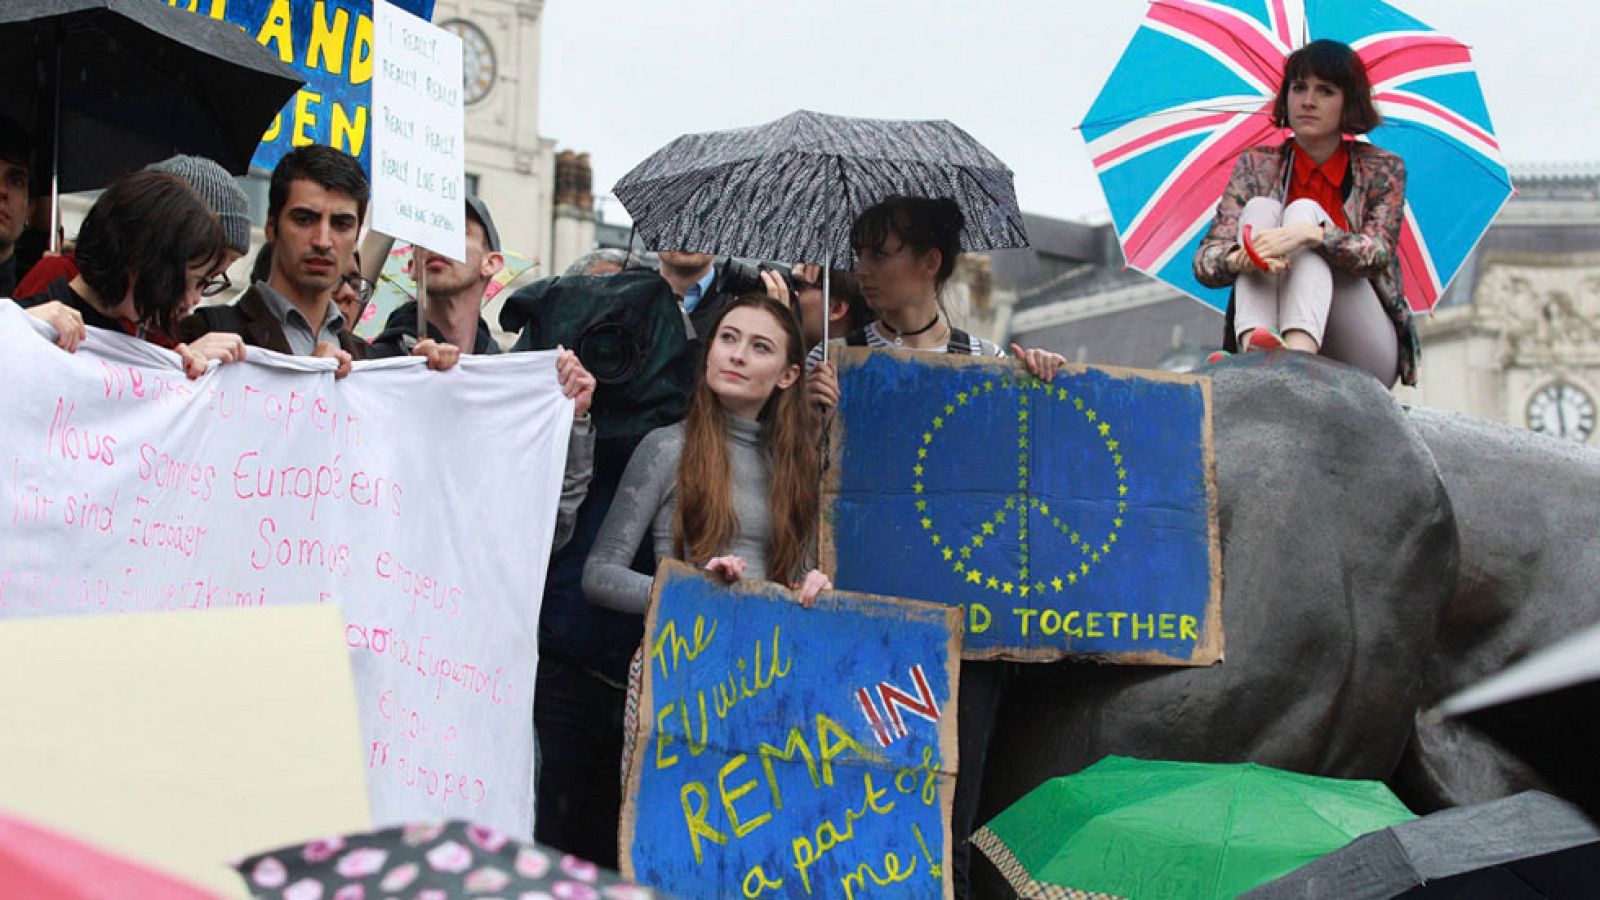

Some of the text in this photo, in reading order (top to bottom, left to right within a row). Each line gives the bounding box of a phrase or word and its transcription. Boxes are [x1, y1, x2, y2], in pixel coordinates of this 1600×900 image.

[101, 359, 147, 399] We
[48, 395, 116, 466] Nous
[63, 486, 120, 535] sind
[652, 614, 718, 680] The
[1013, 608, 1198, 641] TOGETHER
[656, 624, 792, 769] EU will
[743, 745, 942, 898] a part of
